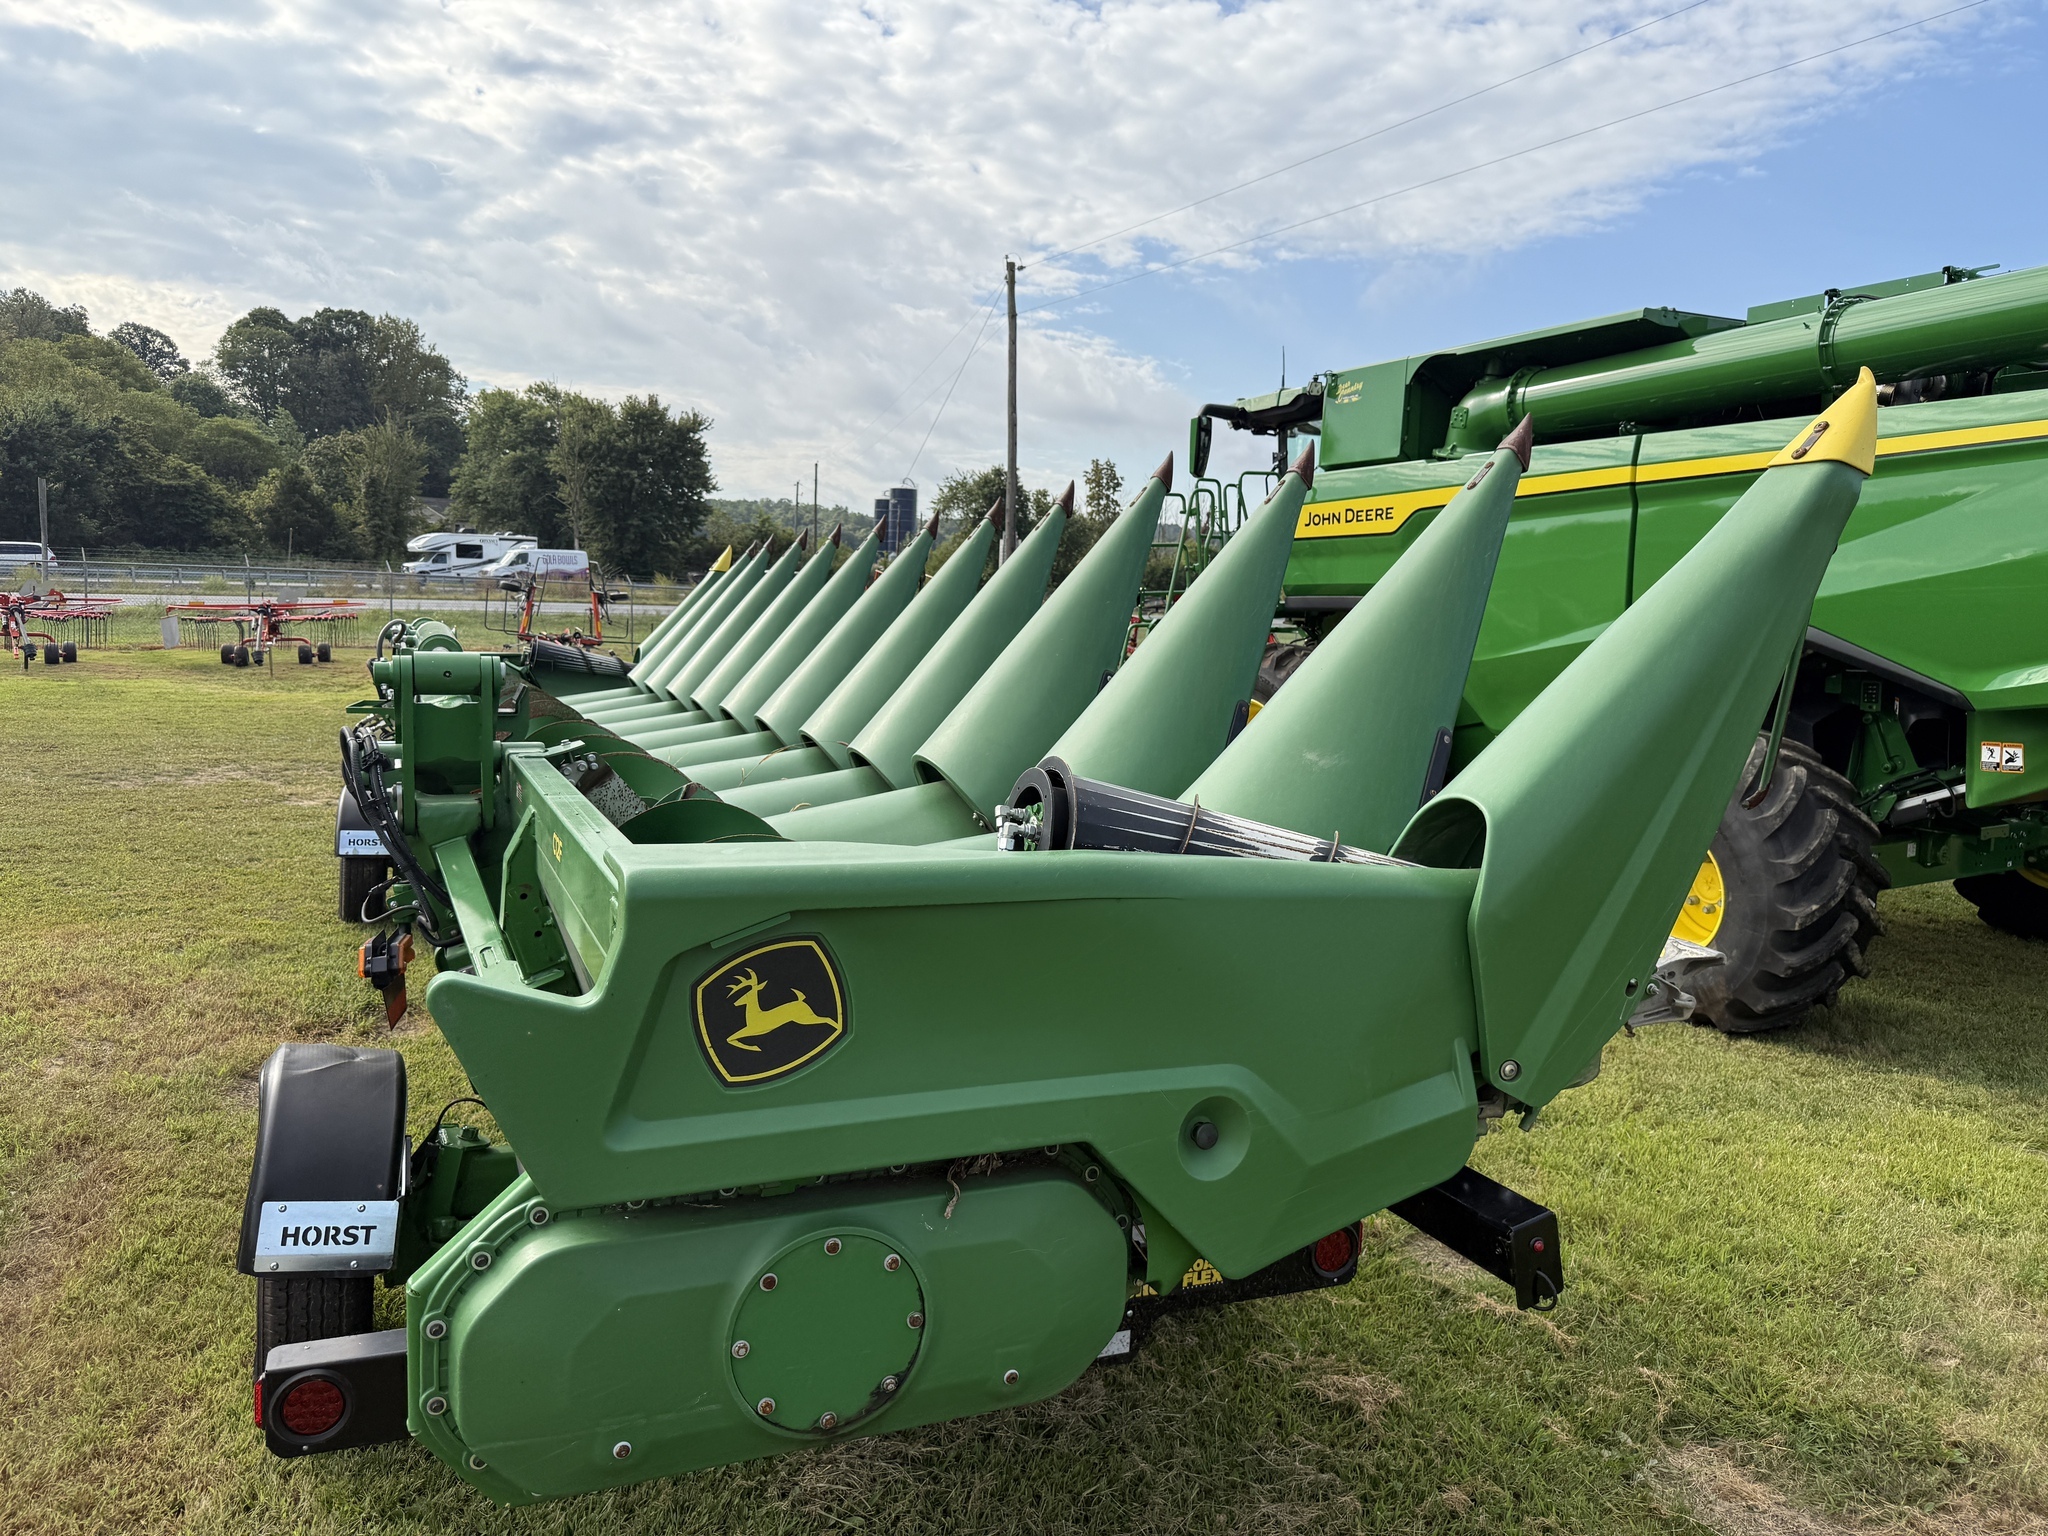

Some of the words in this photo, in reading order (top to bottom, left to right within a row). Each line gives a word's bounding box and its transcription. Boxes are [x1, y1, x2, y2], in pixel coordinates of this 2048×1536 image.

[1304, 512, 1341, 527] JOHN
[1345, 507, 1394, 523] DEERE
[557, 554, 578, 565] BOWLS
[280, 1225, 378, 1246] HORST
[1182, 1268, 1224, 1288] FLEX
